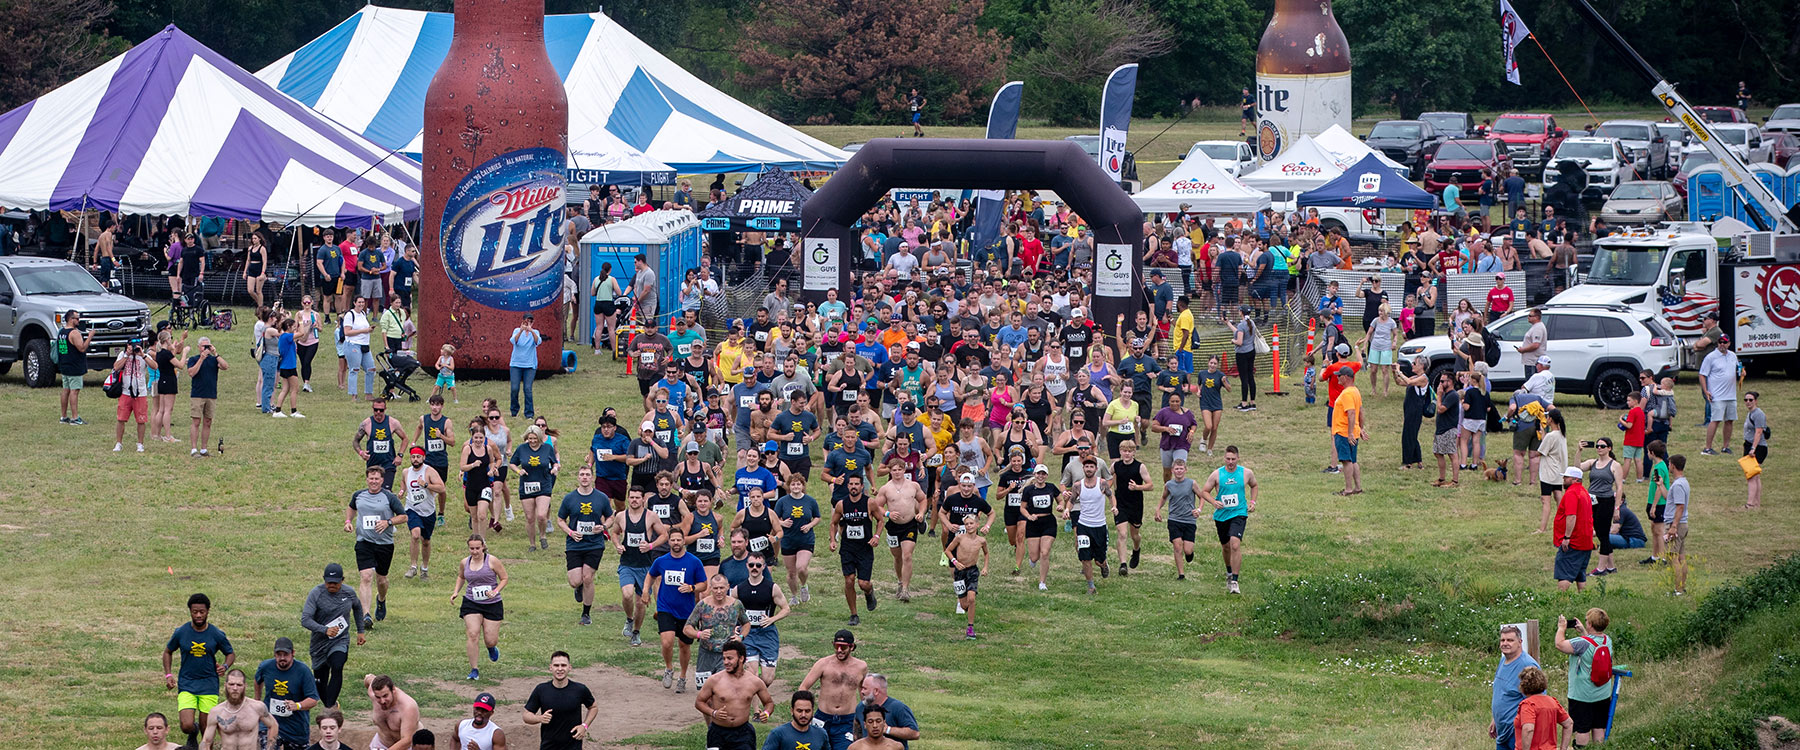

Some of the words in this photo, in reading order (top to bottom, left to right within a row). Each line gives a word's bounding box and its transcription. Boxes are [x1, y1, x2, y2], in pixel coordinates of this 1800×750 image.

[1256, 84, 1288, 118] ite
[1683, 114, 1708, 140] PALFINGER
[1105, 137, 1124, 153] Lite
[1281, 163, 1321, 173] Coors
[567, 170, 609, 183] IGHT
[651, 172, 669, 184] FLIGHT
[1172, 180, 1215, 190] Coors
[490, 185, 560, 218] Miller
[738, 199, 795, 214] PRIME
[705, 219, 727, 229] PRIME
[756, 218, 777, 228] PRIME
[469, 204, 565, 282] Lite
[1748, 333, 1780, 341] 316-206-0911
[1754, 340, 1787, 348] OPERATIONS
[580, 525, 592, 533] 708
[630, 537, 641, 545] 967
[752, 540, 768, 549] 1159
[668, 575, 681, 583] 516
